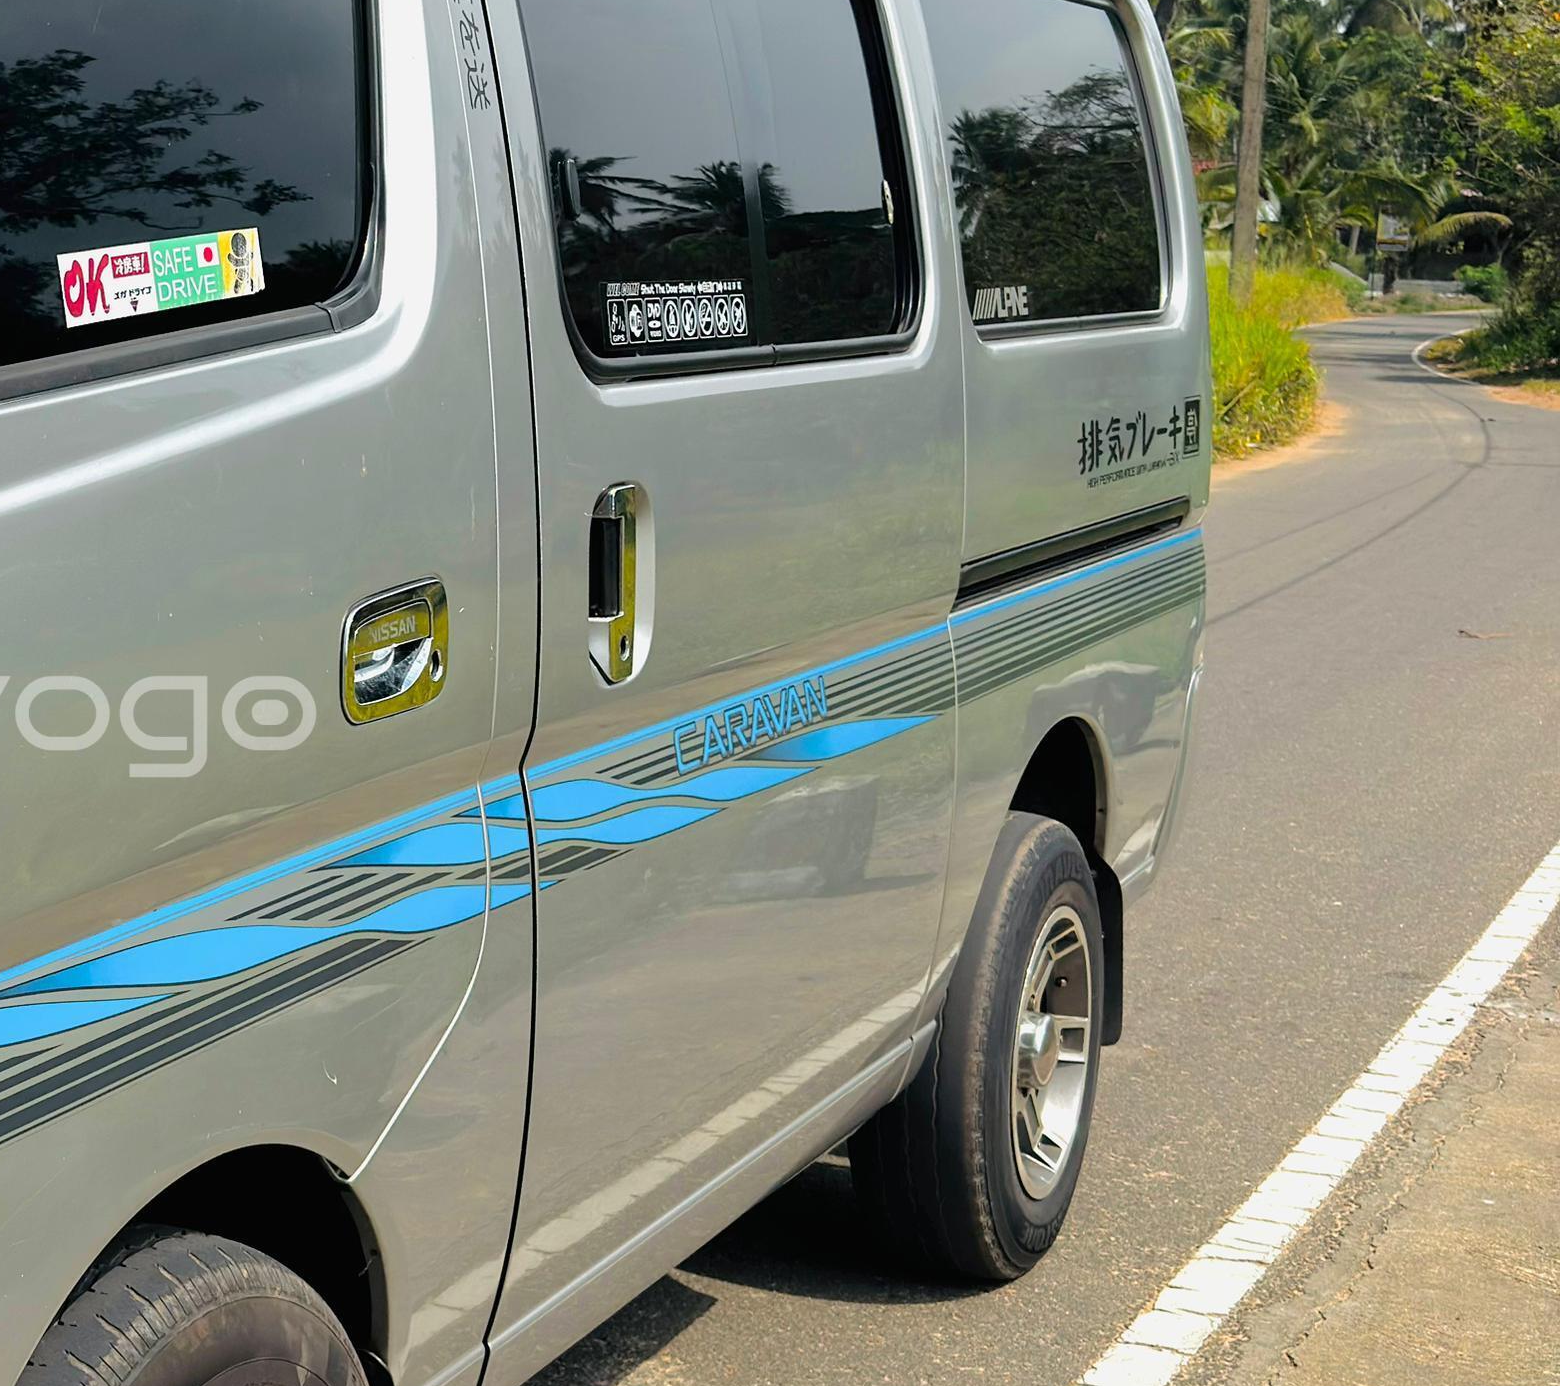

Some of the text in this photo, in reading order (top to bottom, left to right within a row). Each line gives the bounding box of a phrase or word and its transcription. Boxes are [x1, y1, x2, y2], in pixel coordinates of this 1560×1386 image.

[64, 254, 111, 317] OK
[153, 246, 194, 278] SAFE
[158, 274, 218, 303] DRIVE
[612, 333, 626, 342] GPS
[1077, 404, 1182, 475] 排気ブレーキ
[673, 675, 829, 777] CARAVAN
